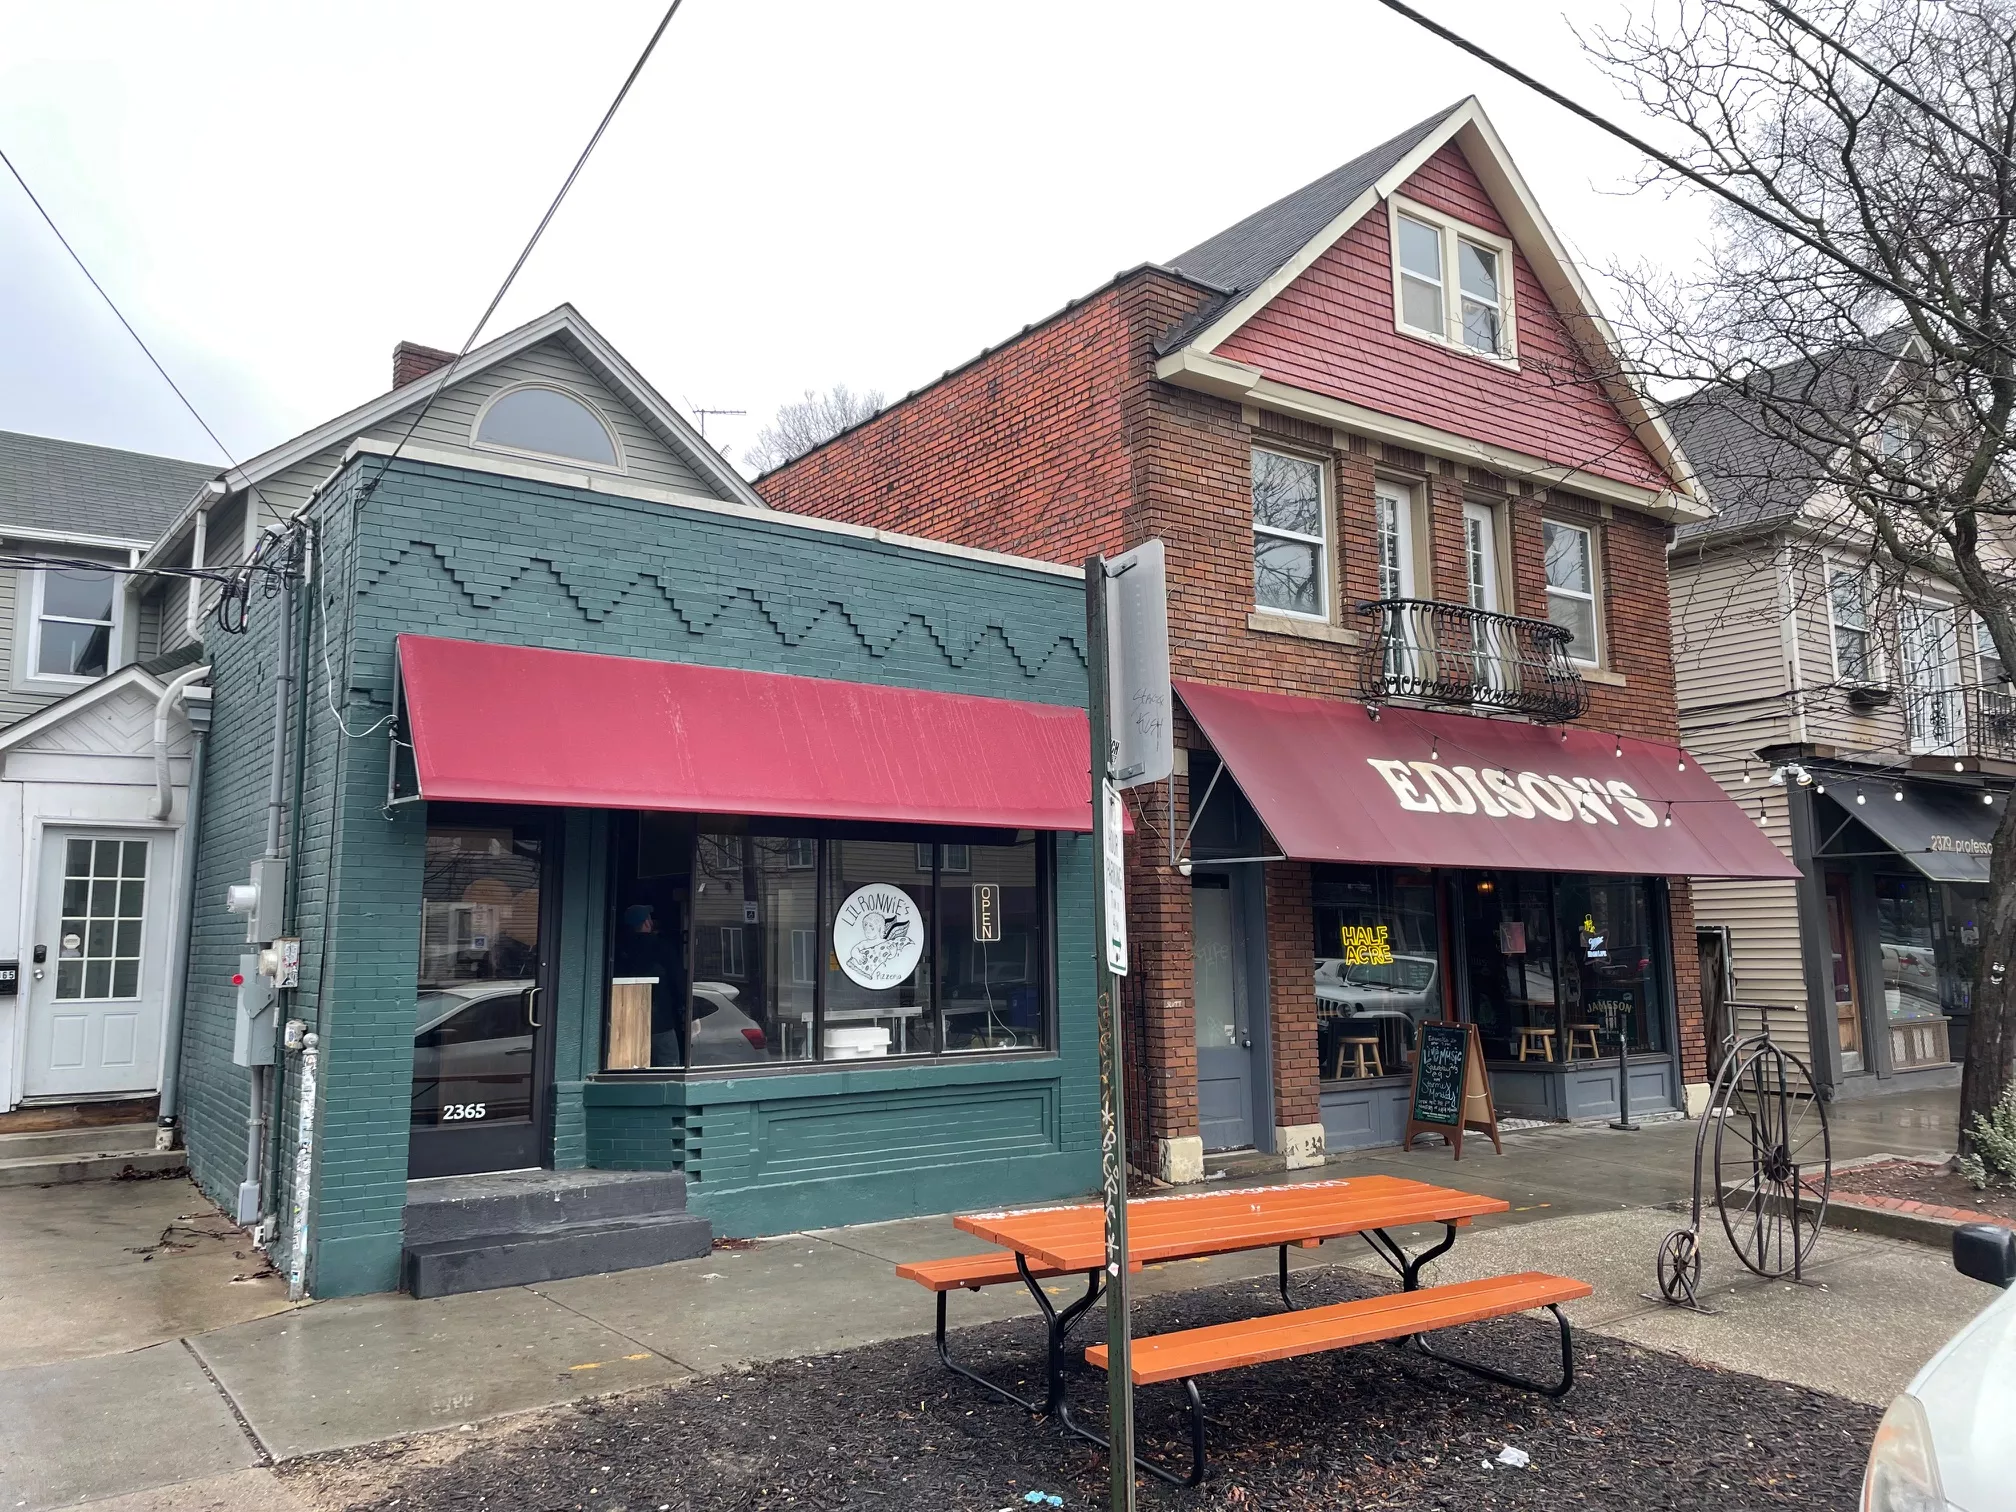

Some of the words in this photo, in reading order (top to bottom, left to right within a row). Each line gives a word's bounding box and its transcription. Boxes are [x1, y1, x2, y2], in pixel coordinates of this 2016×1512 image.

[1366, 758, 1659, 828] EDISON'S
[1931, 835, 1951, 851] 2379
[1955, 839, 1994, 855] professo
[841, 904, 862, 927] LIL
[981, 886, 992, 939] OPEN
[1341, 925, 1388, 946] HALF
[1345, 944, 1394, 966] ACRE
[0, 971, 14, 979] 65
[1586, 1000, 1633, 1014] JAMESON
[442, 1103, 486, 1120] 2365
